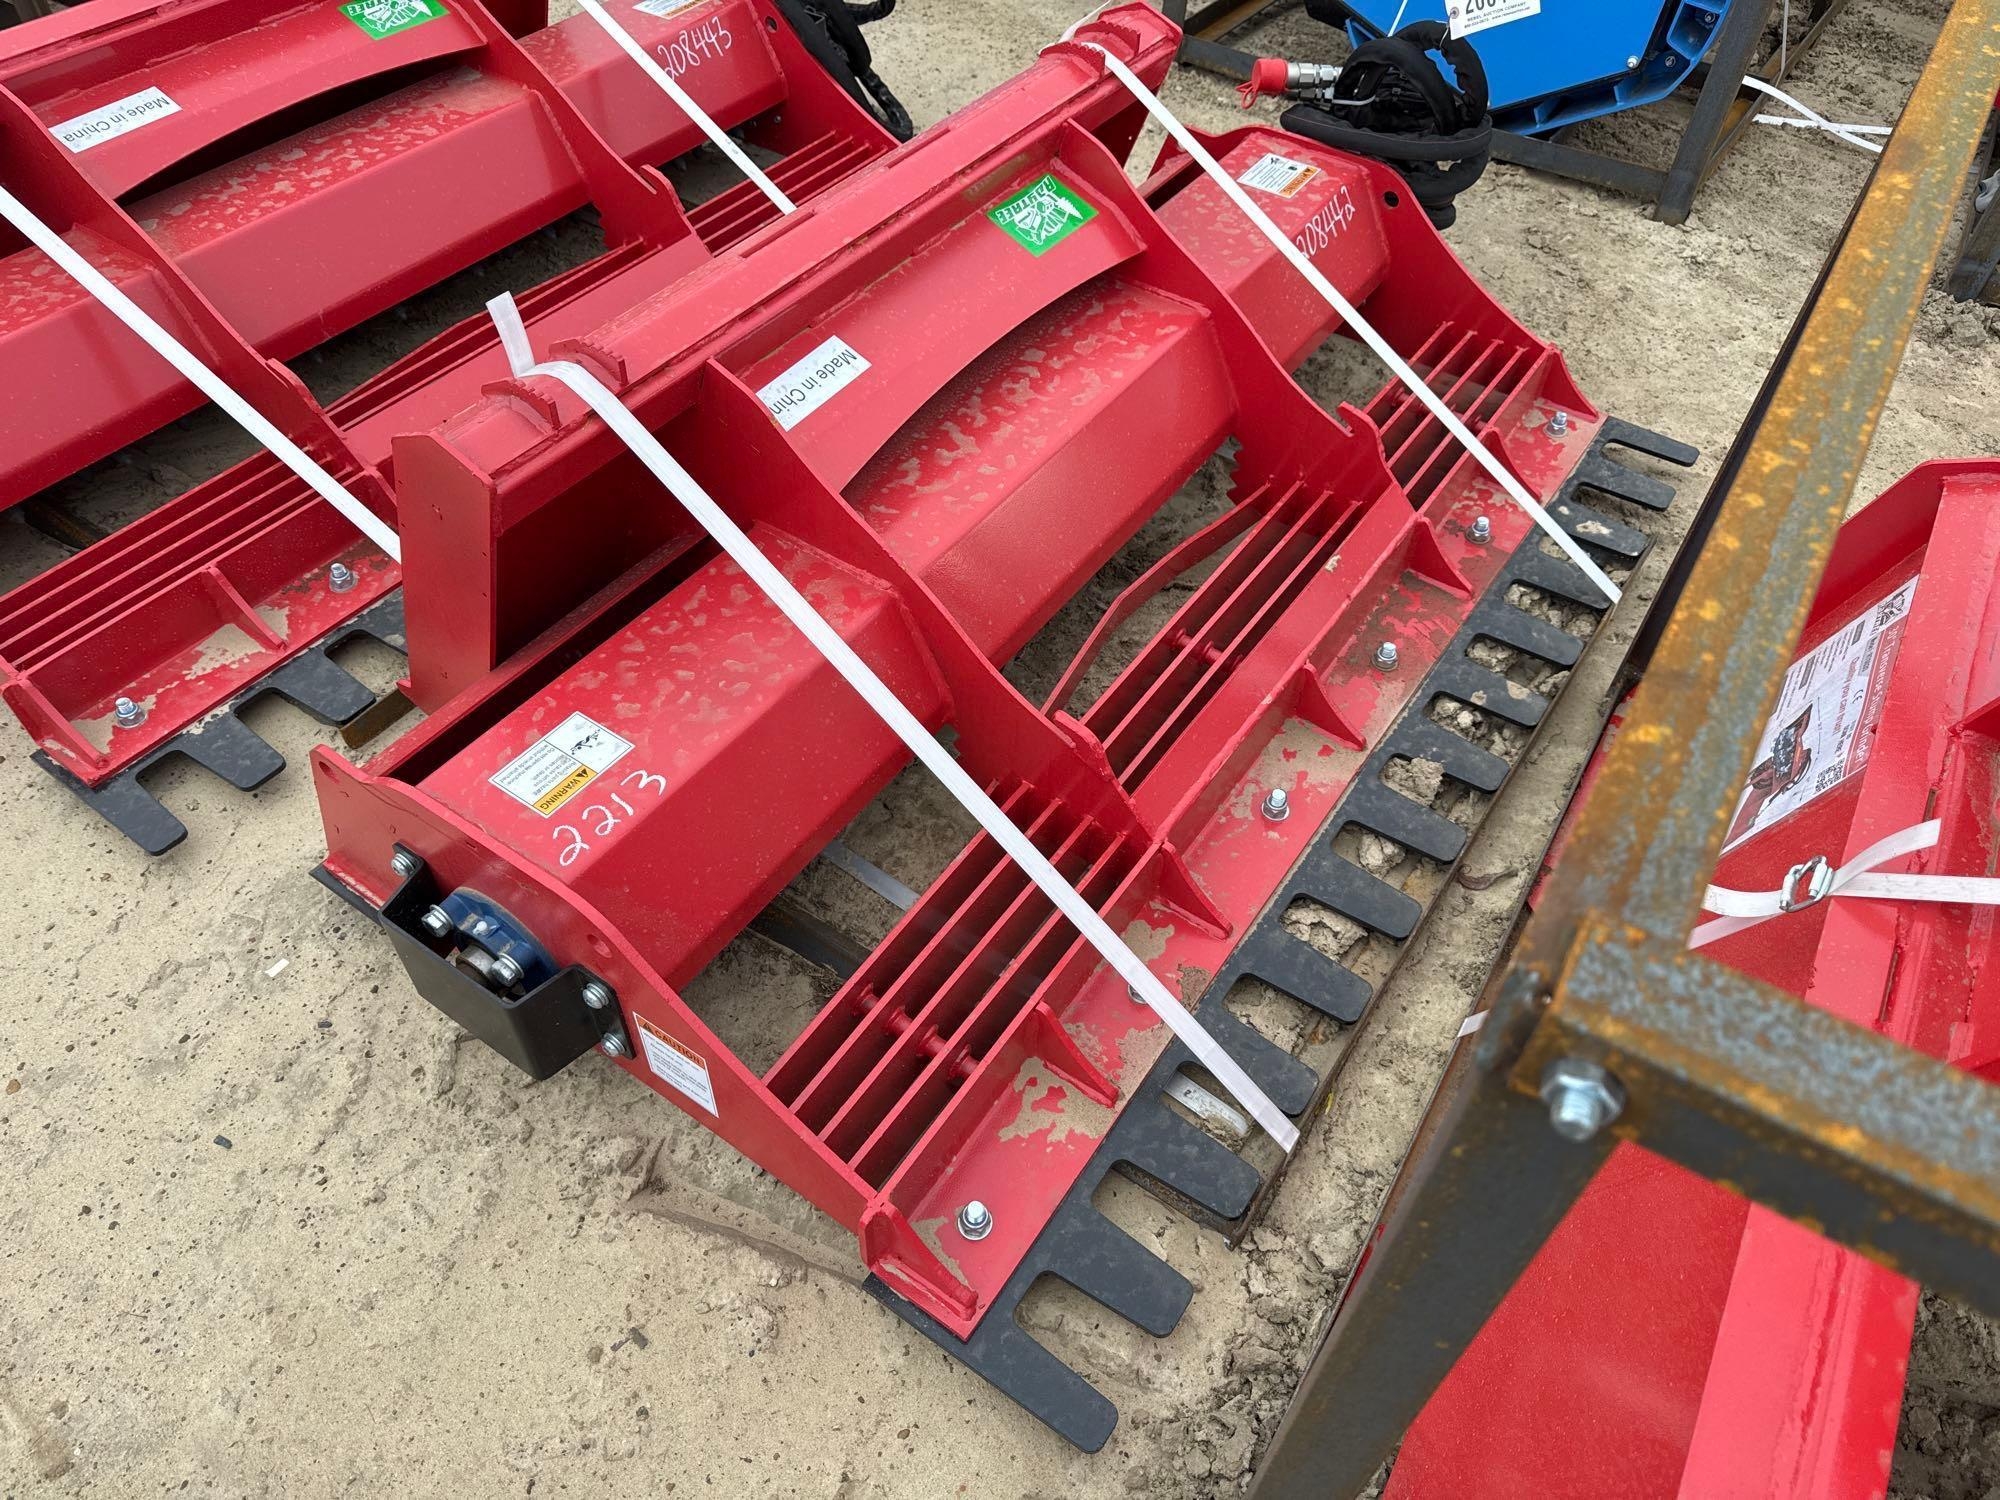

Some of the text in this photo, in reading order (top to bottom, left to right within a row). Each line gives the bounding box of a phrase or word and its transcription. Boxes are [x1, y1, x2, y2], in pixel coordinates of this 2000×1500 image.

[1504, 1, 1526, 11] COMPANY
[657, 16, 732, 81] 208443
[63, 97, 171, 142] Made in China
[995, 175, 1056, 225] RAYTREE
[1296, 185, 1356, 259] 208442
[769, 349, 857, 415] Made in Chin
[1874, 641, 1896, 692] Transverse
[1864, 691, 1883, 724] Stump
[1854, 723, 1874, 764] Grinder
[540, 778, 581, 810] WARNING
[552, 769, 667, 866] 2213
[655, 1030, 701, 1064] CAUTION
